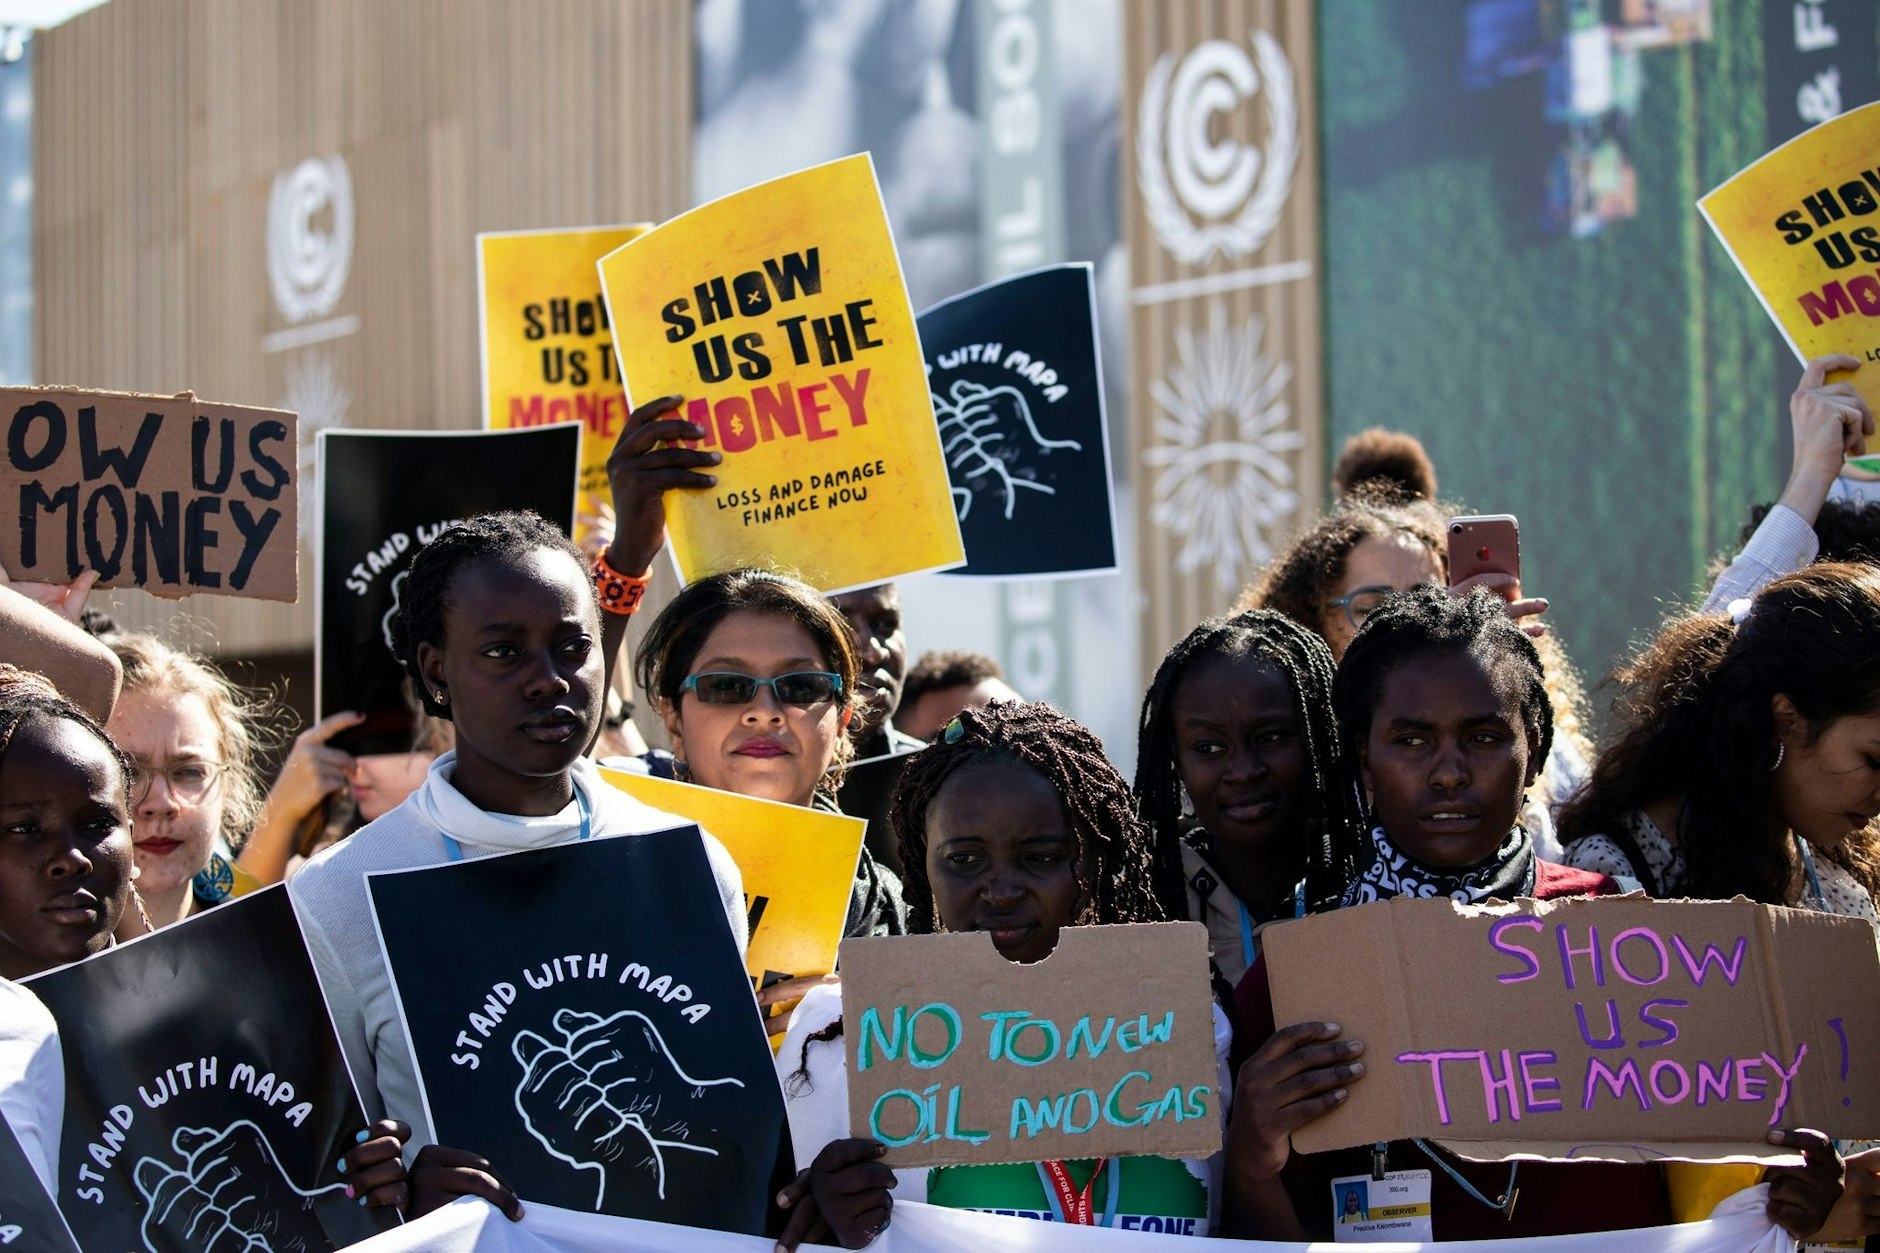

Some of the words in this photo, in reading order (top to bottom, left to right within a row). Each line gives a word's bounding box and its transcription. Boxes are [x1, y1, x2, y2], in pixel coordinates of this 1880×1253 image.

[1813, 226, 1880, 269] US
[661, 247, 822, 343] SHOW
[1798, 268, 1880, 327] MO
[541, 347, 588, 386] US
[692, 332, 772, 383] US
[777, 299, 883, 367] THE
[937, 343, 1003, 369] WITH
[1003, 350, 1069, 403] MAPA
[192, 416, 290, 501] US
[717, 488, 761, 510] LOSS
[769, 479, 803, 501] AND
[811, 460, 885, 488] DAMAGE
[19, 479, 281, 590] MONEY
[743, 495, 819, 527] FINANCE
[828, 487, 868, 508] NOW
[345, 532, 410, 596] STAND
[1488, 915, 1747, 989] SHOW
[451, 982, 517, 1070] STAND
[523, 953, 608, 990] WITH
[619, 962, 711, 1024] MAPA
[858, 1003, 963, 1072] NO
[979, 1010, 1061, 1067] TO
[1574, 1000, 1689, 1049] US
[1395, 1049, 1563, 1125] THE
[1581, 1043, 1808, 1126] MONEY
[77, 1104, 134, 1205] STAND
[138, 1056, 217, 1109] WITH
[229, 1063, 313, 1128] MAPA
[1050, 1160, 1062, 1177] ACE
[1382, 1207, 1417, 1217] OBSERVER
